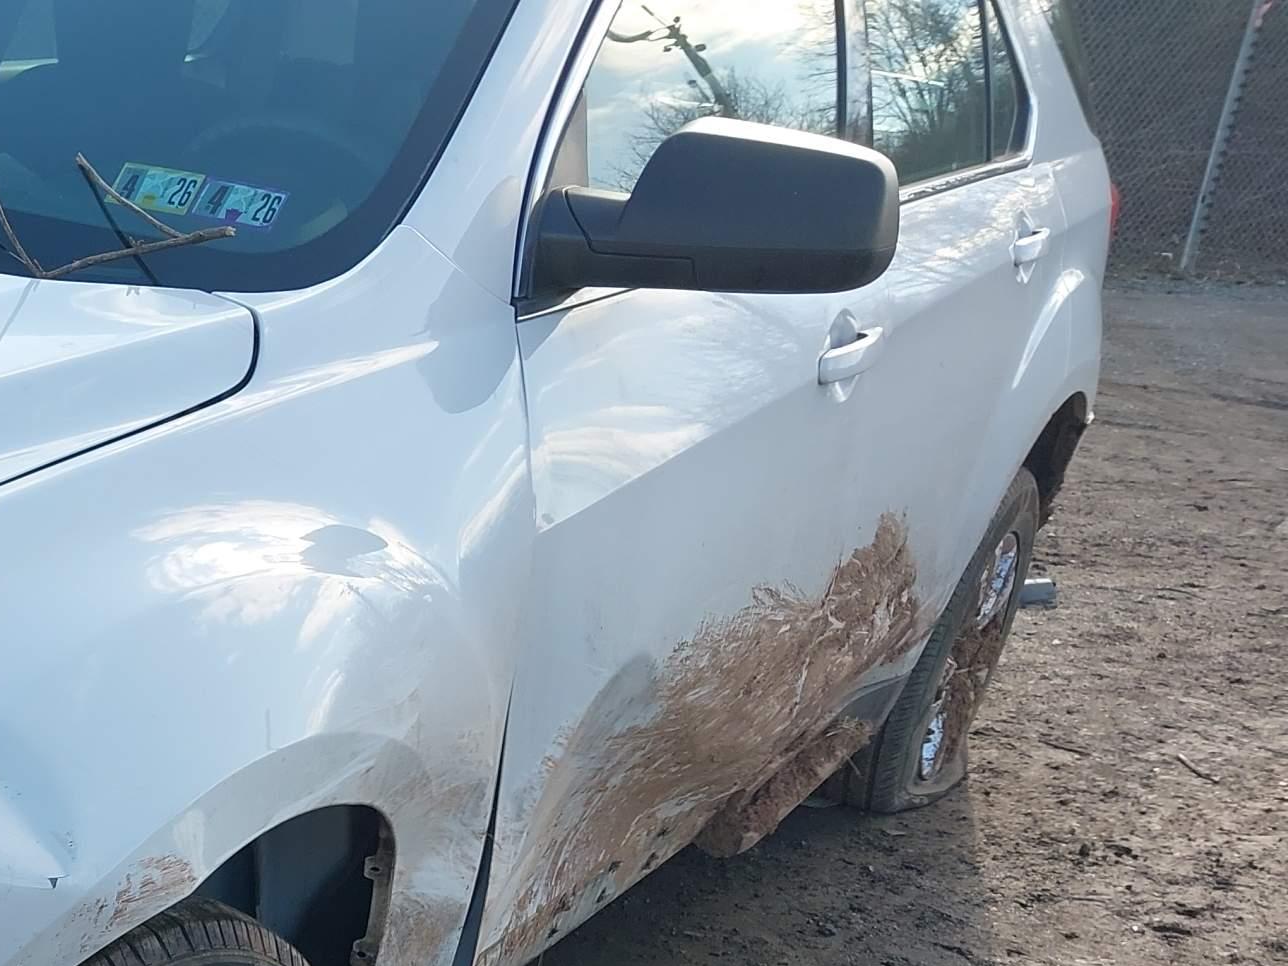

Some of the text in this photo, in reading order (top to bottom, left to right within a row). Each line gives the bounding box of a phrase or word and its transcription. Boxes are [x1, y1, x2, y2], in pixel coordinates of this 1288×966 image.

[119, 174, 198, 207] 4 26
[208, 185, 283, 223] 4 26
